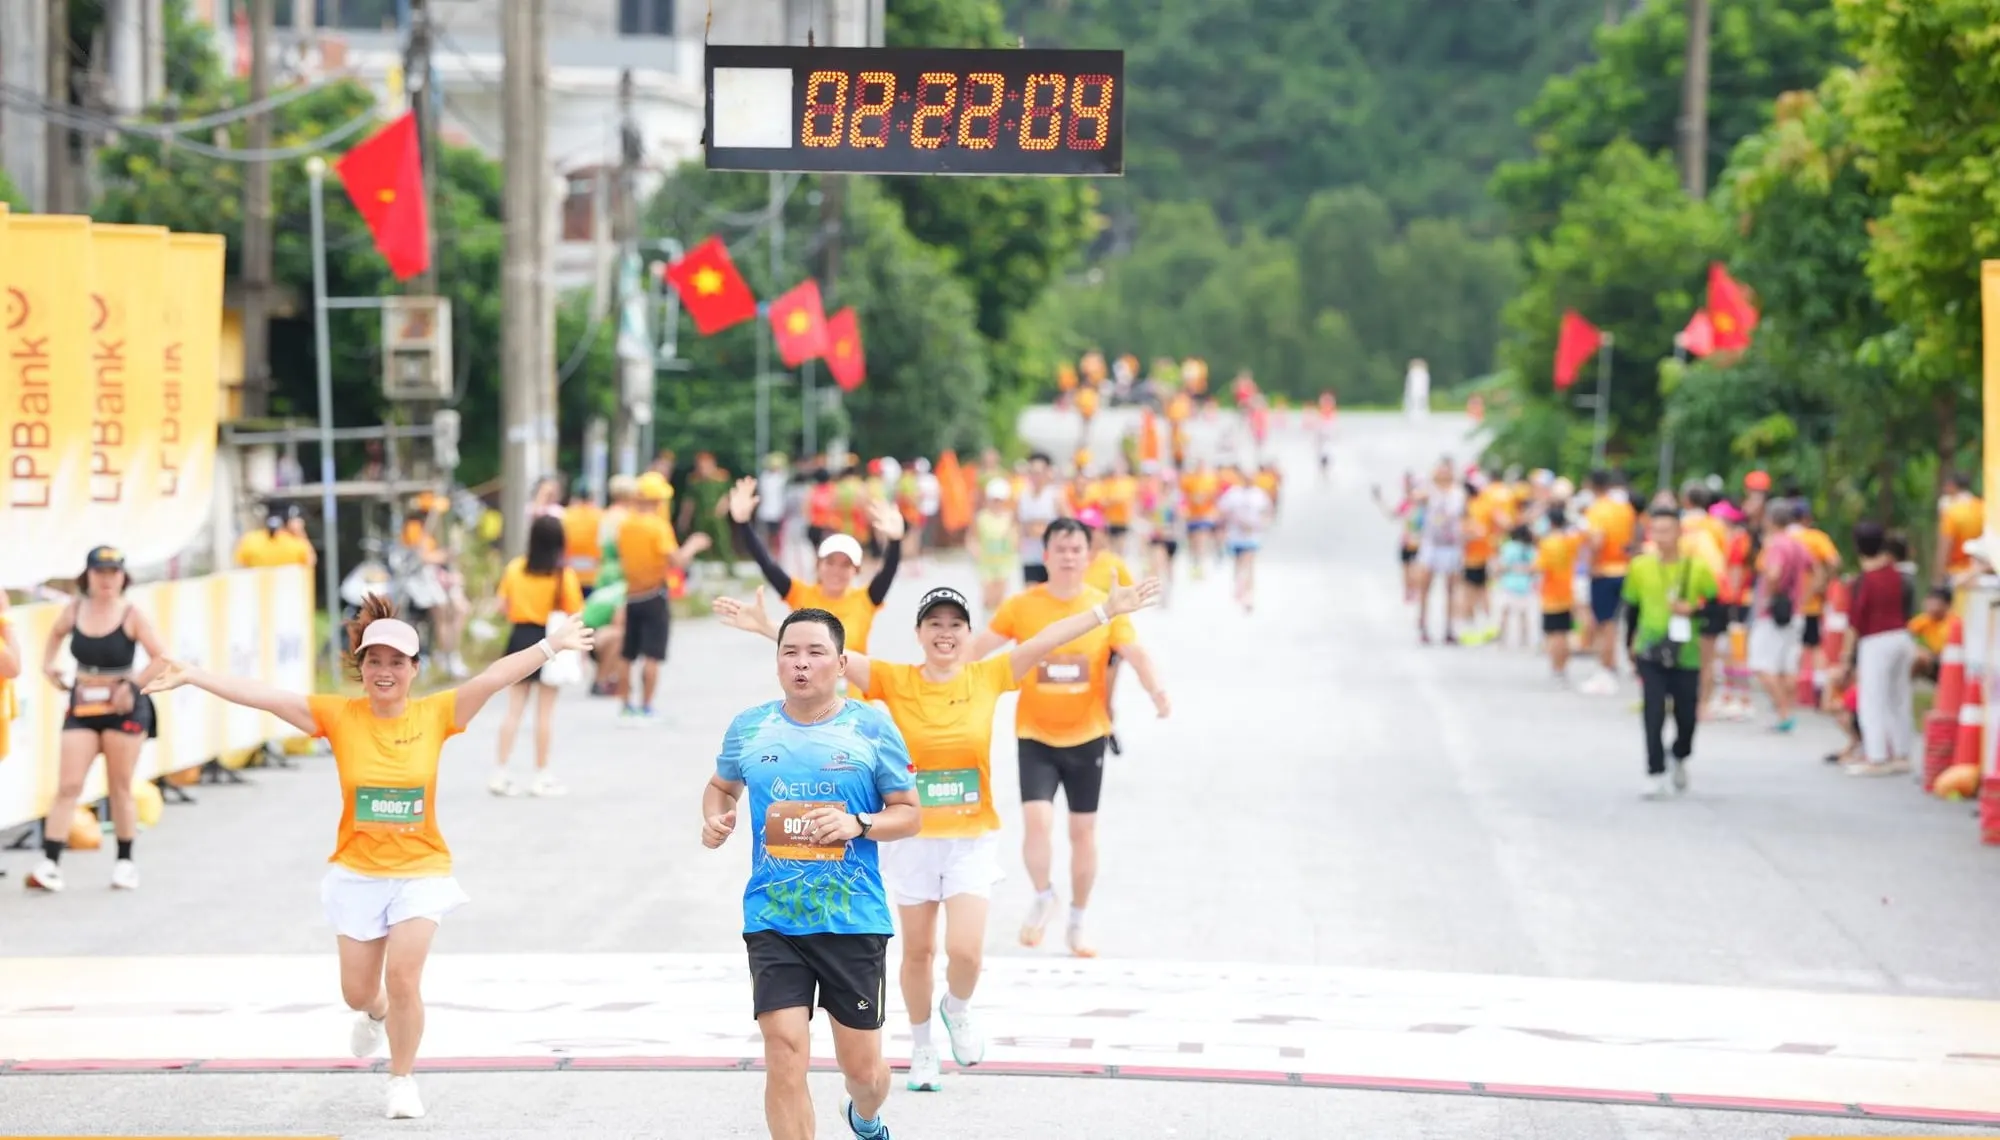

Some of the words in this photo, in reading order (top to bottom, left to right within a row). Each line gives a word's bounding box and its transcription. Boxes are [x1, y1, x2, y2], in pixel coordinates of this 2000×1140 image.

[11, 336, 50, 508] LPBank
[91, 339, 125, 502] LPBank
[790, 781, 836, 797] ETUGI
